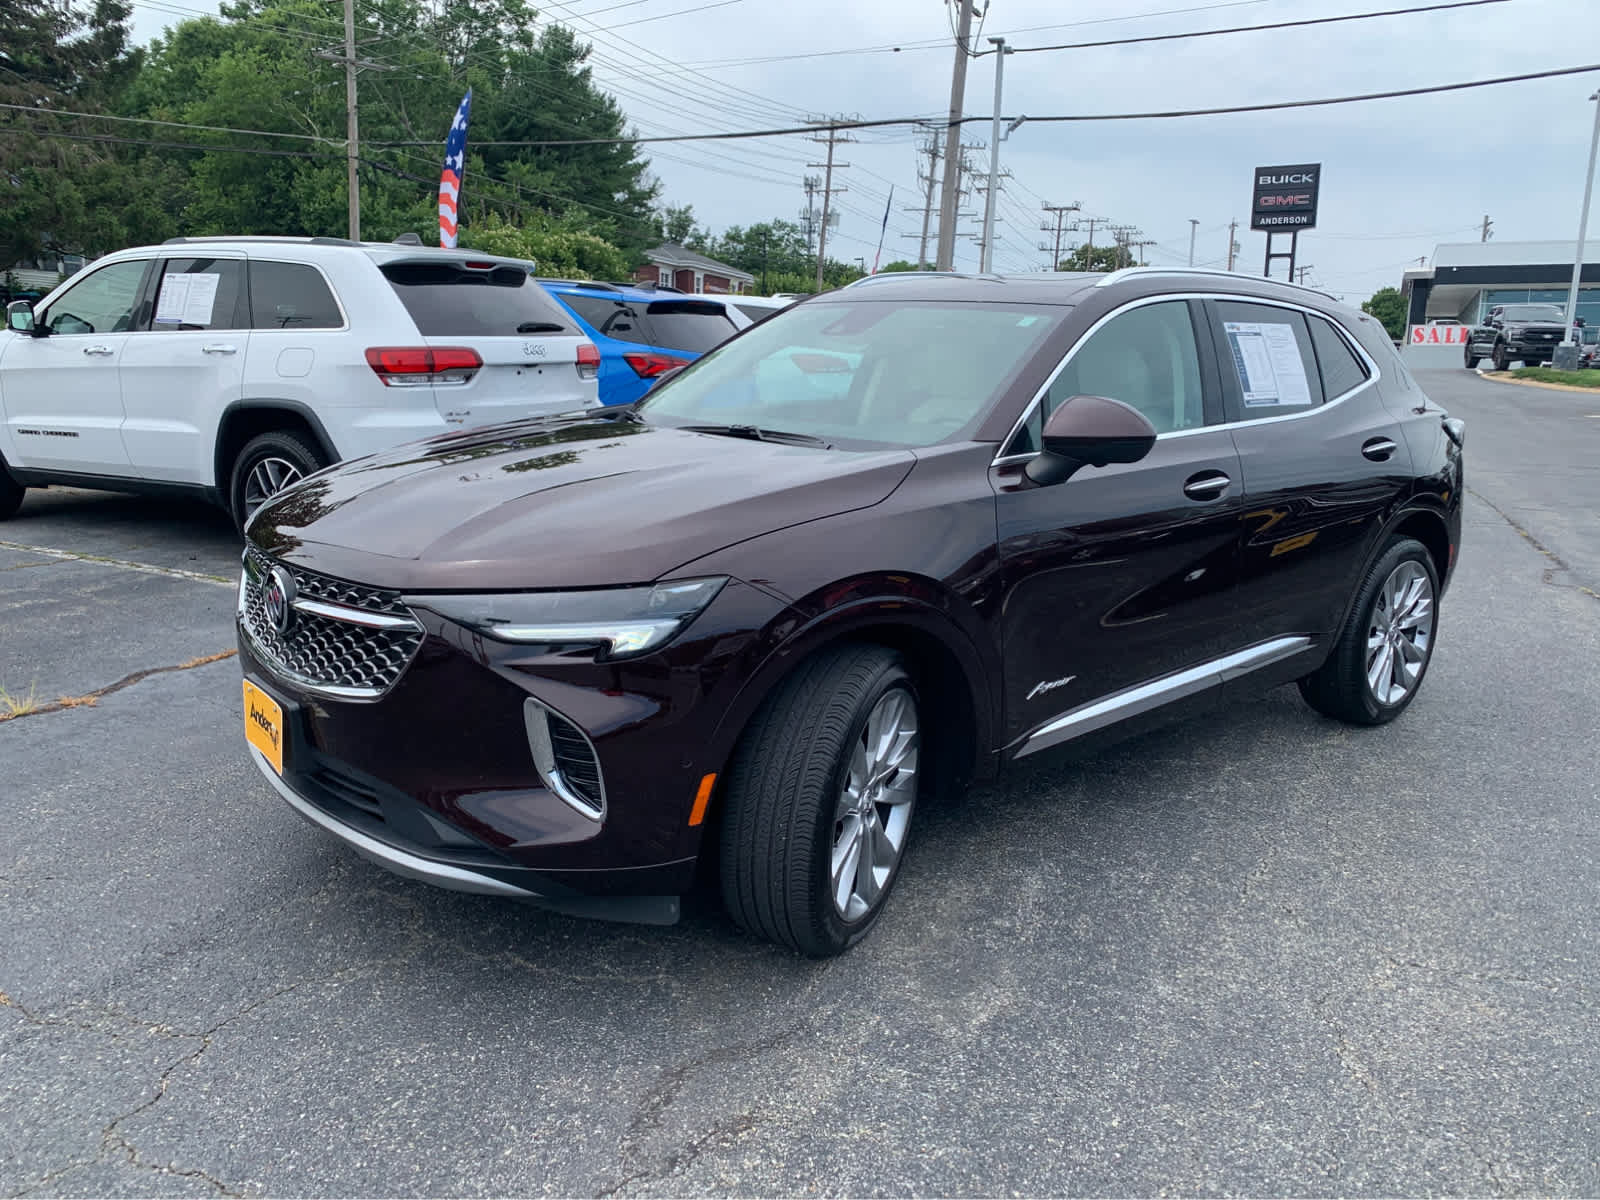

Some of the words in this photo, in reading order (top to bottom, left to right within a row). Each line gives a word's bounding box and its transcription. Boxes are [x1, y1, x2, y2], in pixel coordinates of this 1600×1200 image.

[1259, 174, 1314, 185] BUICK
[1259, 194, 1310, 206] GMC
[1259, 216, 1308, 225] ANDERSON
